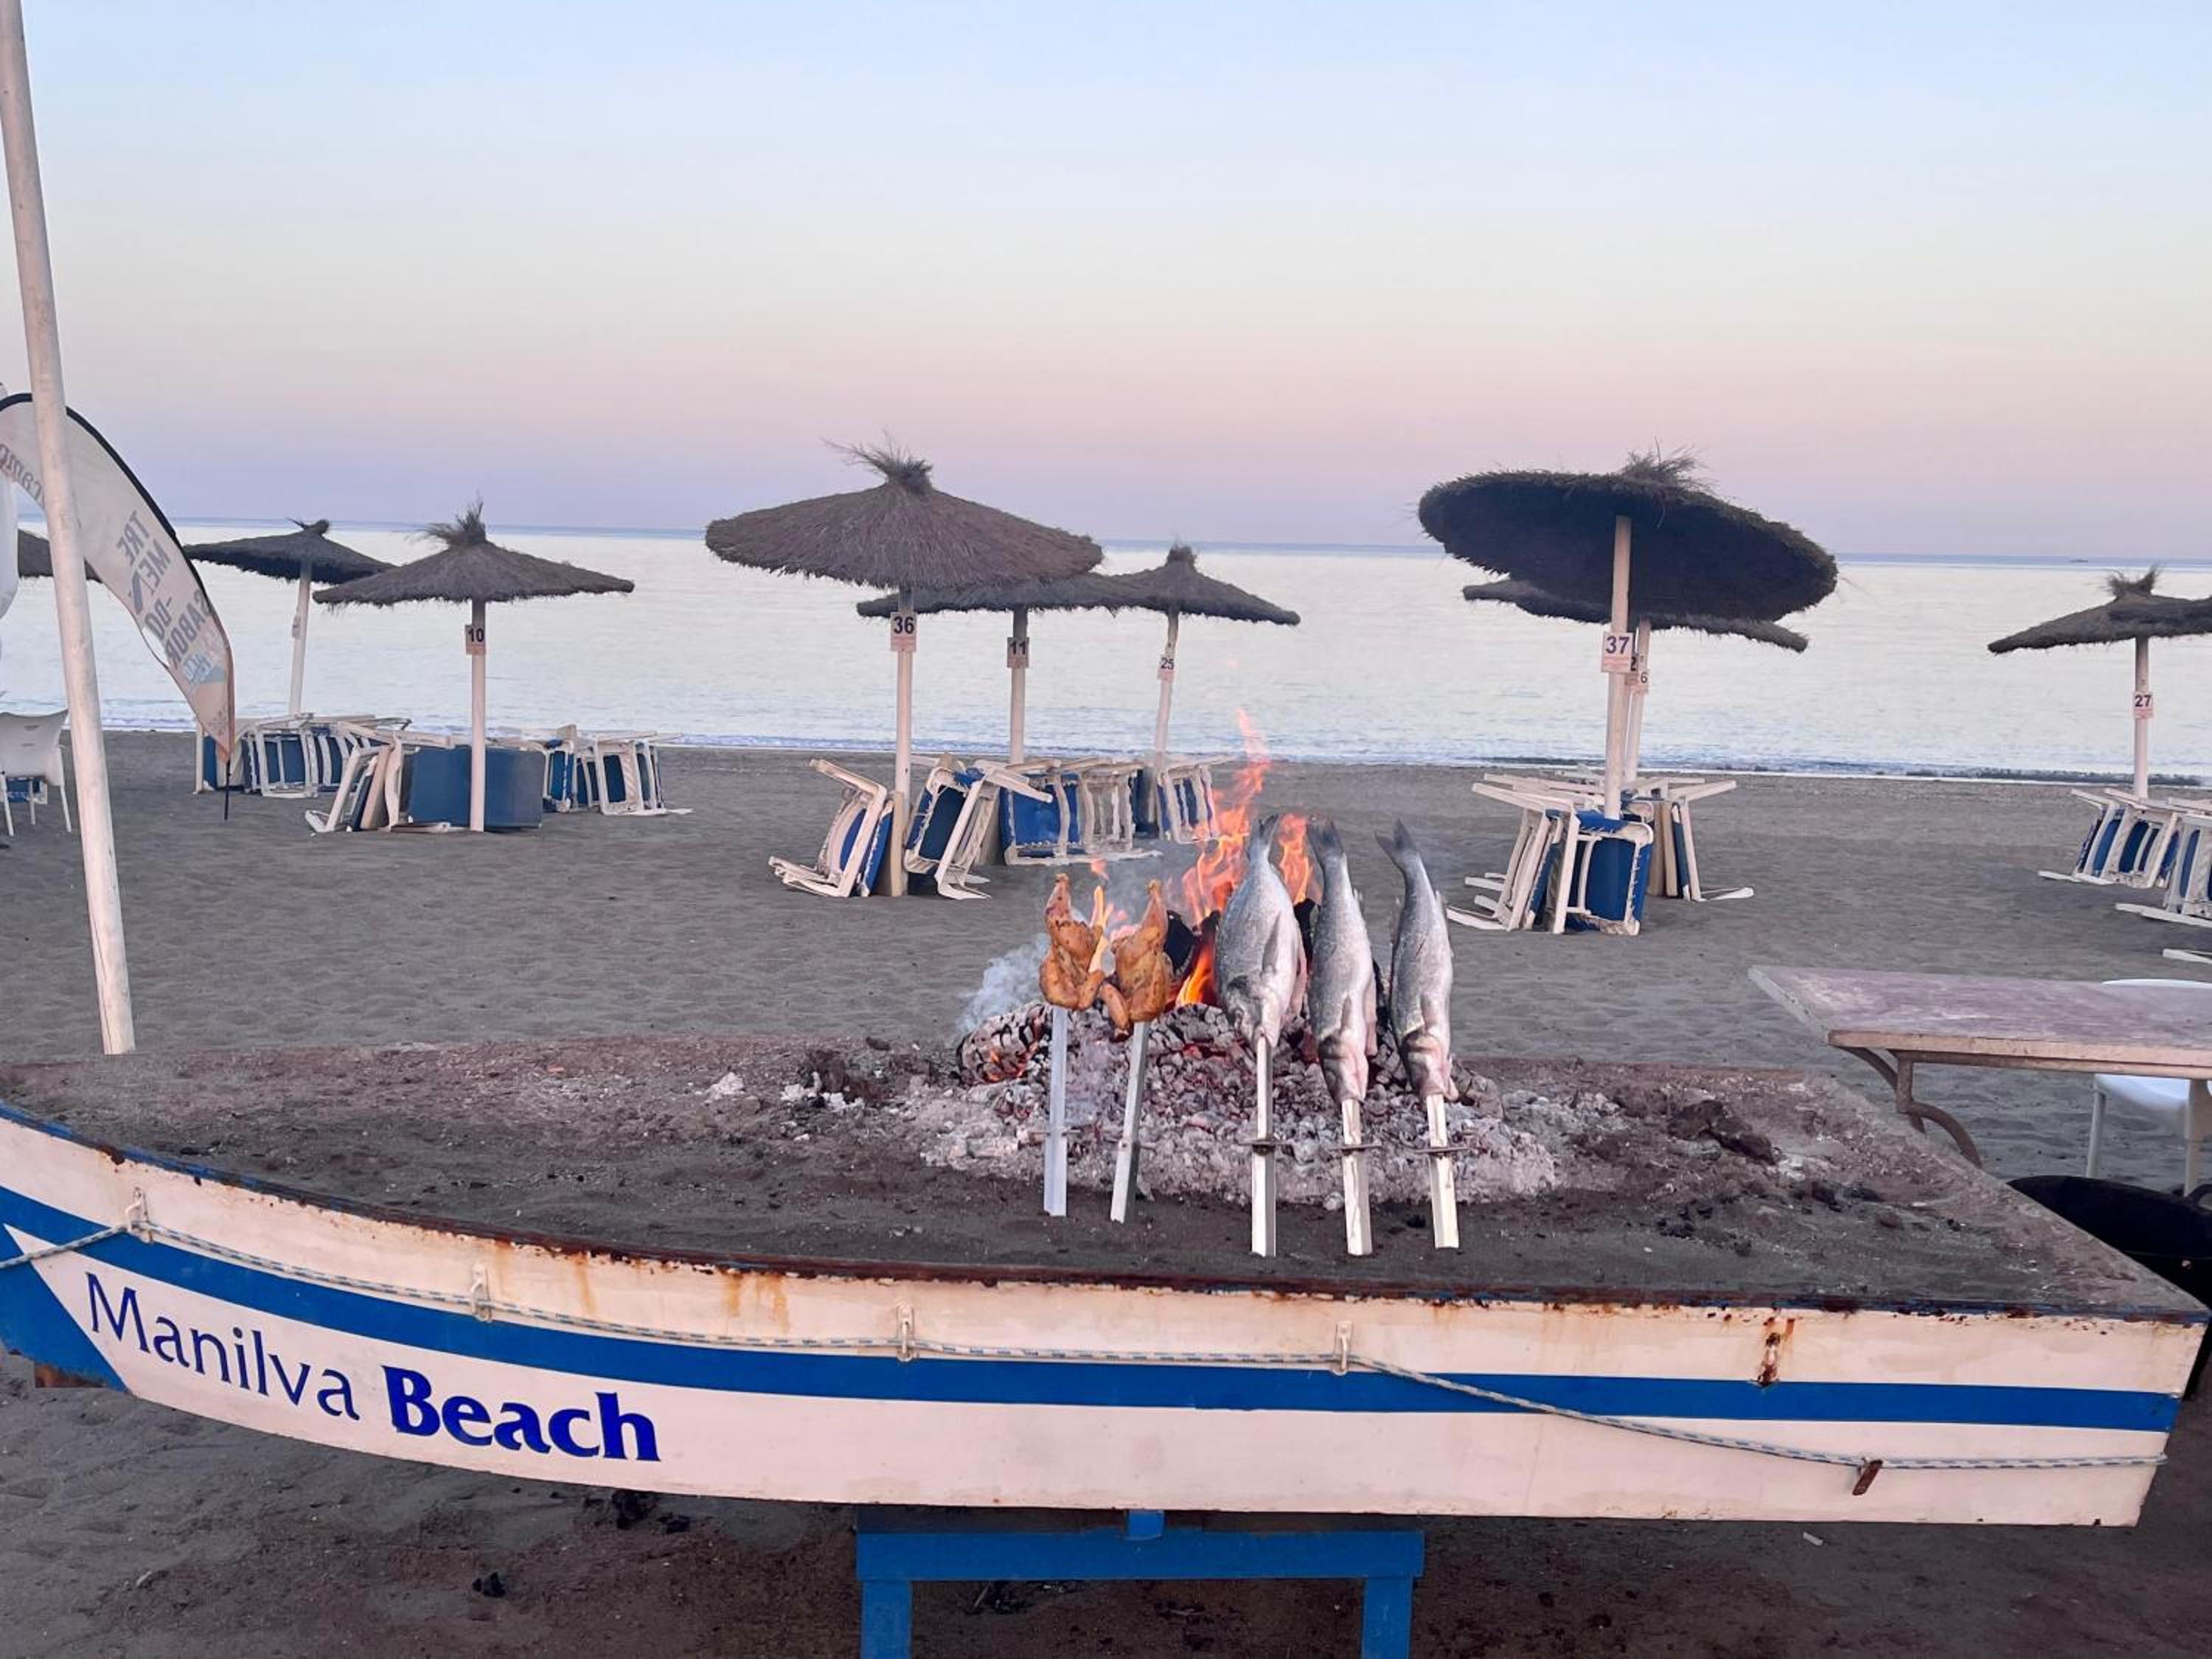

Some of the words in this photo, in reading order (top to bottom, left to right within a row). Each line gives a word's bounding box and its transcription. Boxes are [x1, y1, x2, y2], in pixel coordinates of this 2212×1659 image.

[894, 616, 914, 634] 36
[468, 627, 484, 642] 10
[1009, 640, 1026, 655] 11
[1606, 636, 1630, 654] 37
[1160, 657, 1174, 670] 25
[2135, 694, 2152, 707] 27
[85, 1270, 361, 1421] Manilva
[380, 1365, 661, 1462] Beach
